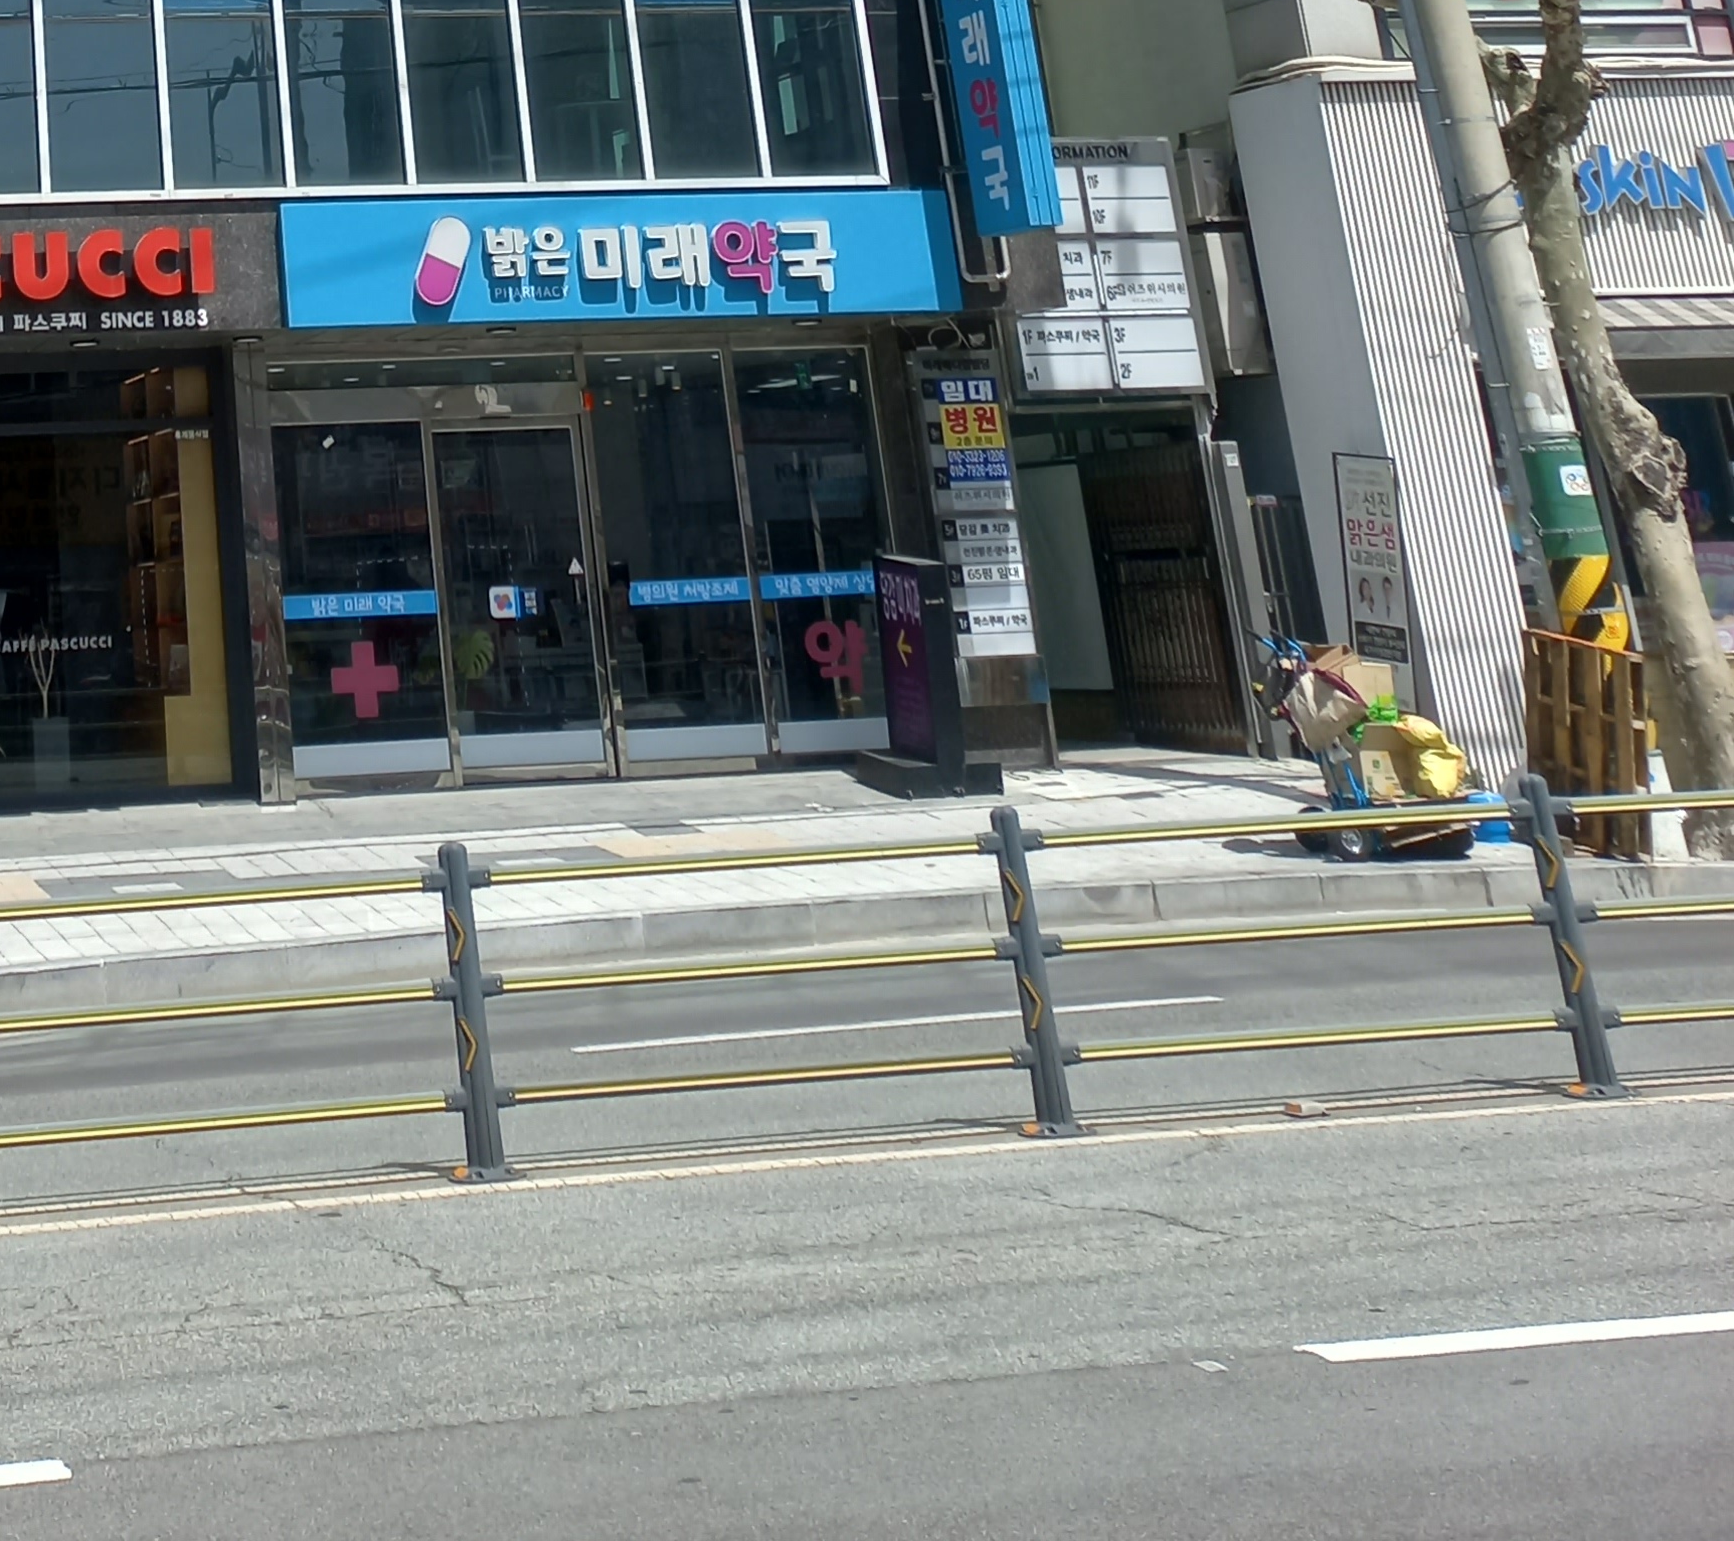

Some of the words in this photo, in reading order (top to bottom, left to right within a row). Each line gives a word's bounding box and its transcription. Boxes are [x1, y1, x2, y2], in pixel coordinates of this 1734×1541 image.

[1052, 145, 1129, 160] ORMATION
[483, 225, 571, 278] 밝은
[577, 220, 838, 294] 미래약국
[494, 284, 570, 299] PHARMACY
[1127, 282, 1187, 297] 쉬즈위시의원
[13, 312, 87, 332] 파스쿠찌
[100, 310, 155, 329] SINCE
[162, 308, 209, 328] 1883
[1081, 329, 1100, 343] 약국
[940, 379, 994, 403] 임대
[944, 406, 998, 435] 병원
[1363, 491, 1392, 518] 선진
[1347, 518, 1396, 551] 맑은샘
[967, 567, 993, 581] 65평
[997, 566, 1020, 579] 임대
[637, 582, 679, 600] 병의원
[683, 581, 740, 599] 처방조제
[774, 578, 802, 595] 맞춤
[806, 575, 849, 594] 영양제
[311, 598, 338, 616] 밝은
[344, 596, 373, 613] 미래
[377, 595, 406, 612] 약국
[40, 634, 114, 652] PASCUCCI
[804, 620, 868, 694] 약
